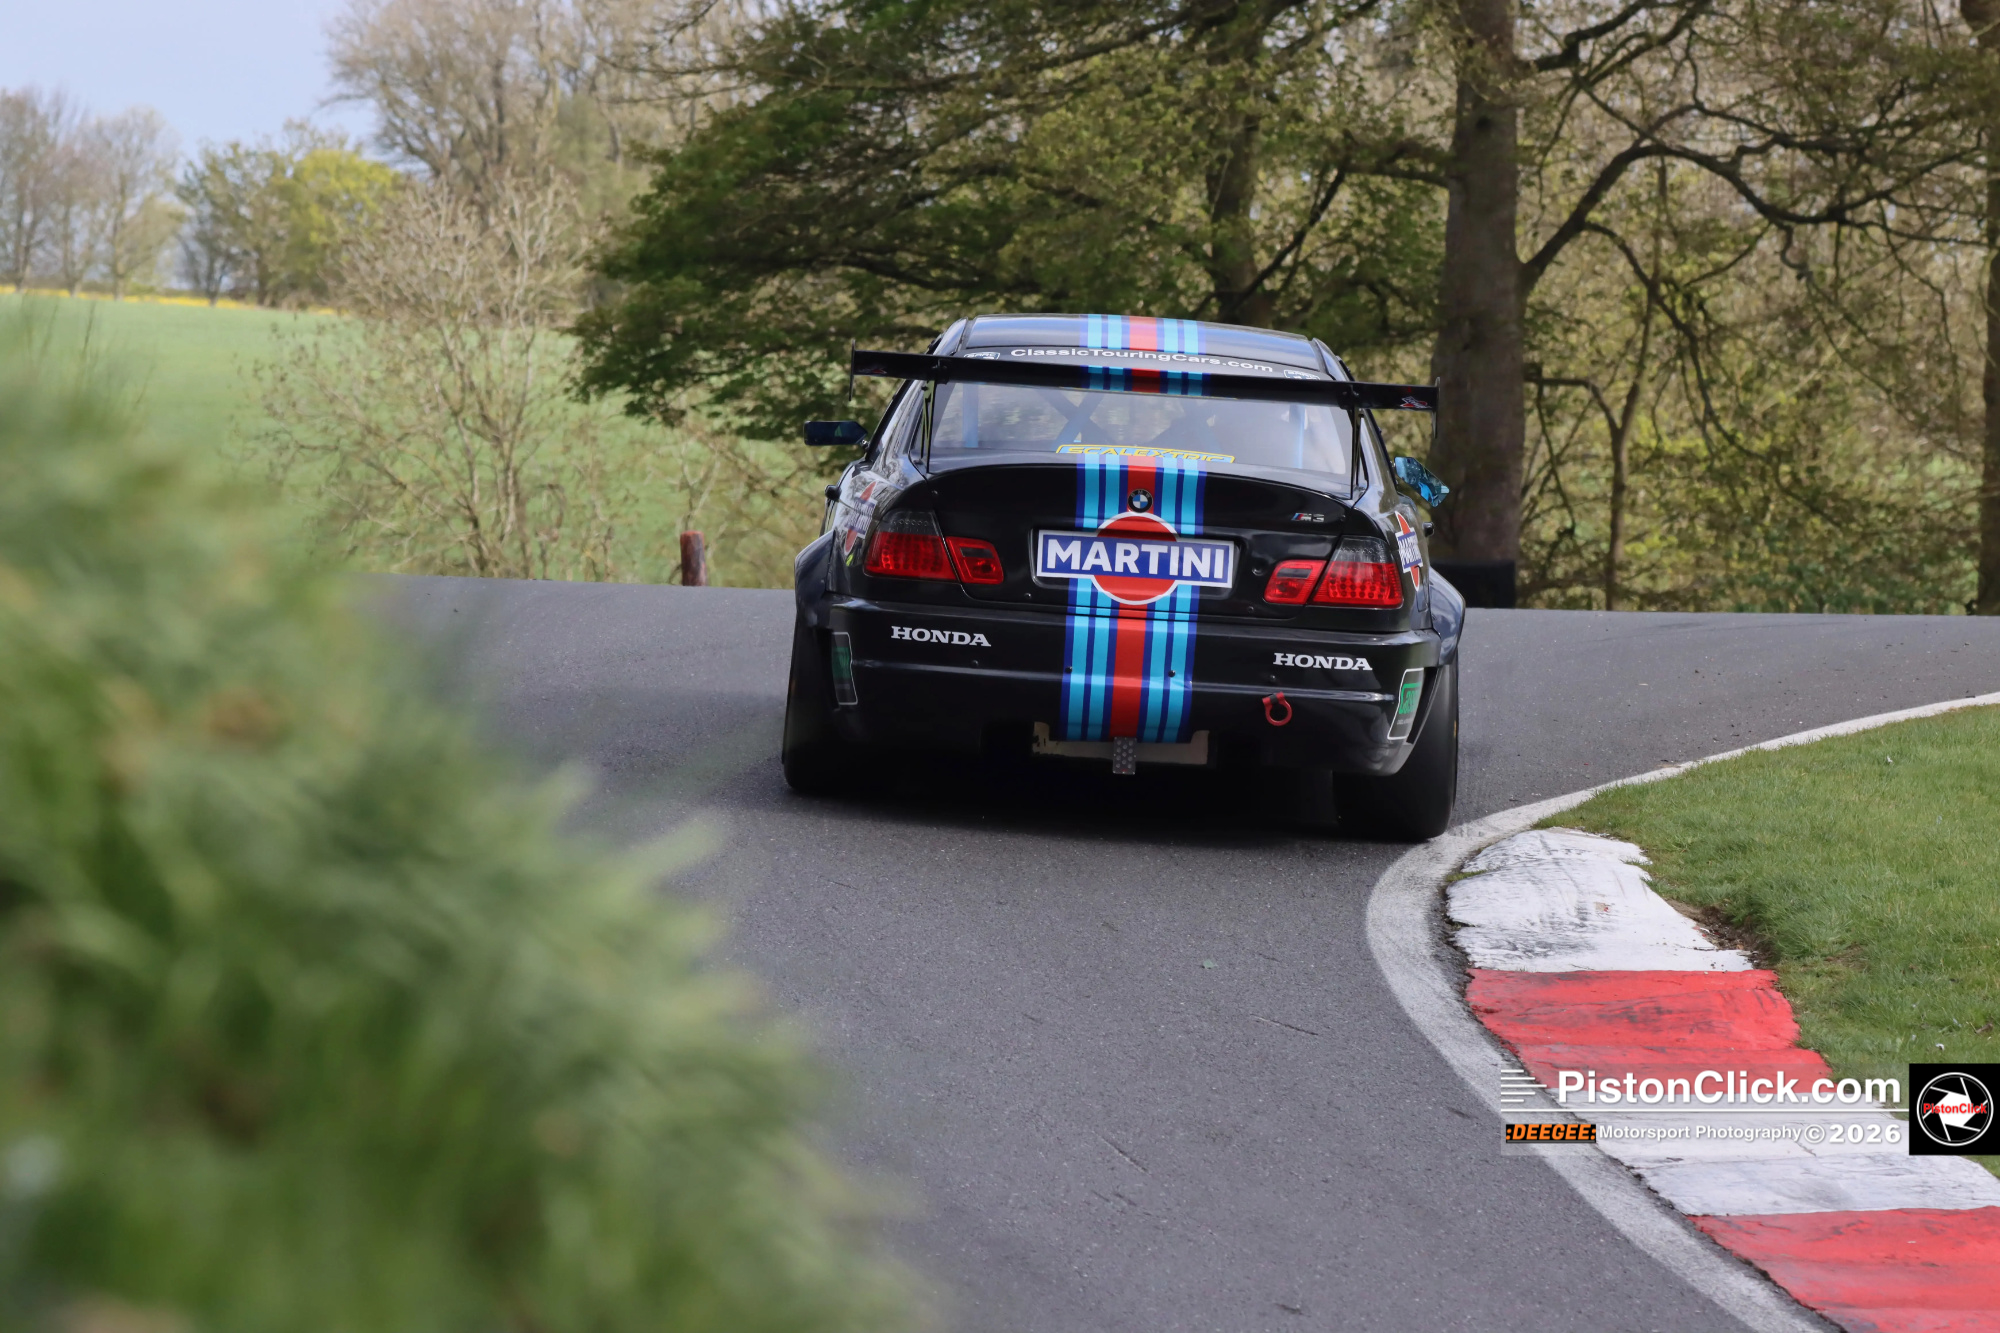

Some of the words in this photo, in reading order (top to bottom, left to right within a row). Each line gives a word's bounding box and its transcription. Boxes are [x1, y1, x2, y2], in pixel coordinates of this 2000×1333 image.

[1010, 348, 1273, 373] ClassicTouringCars.com
[1046, 538, 1225, 579] MARTINI
[890, 625, 992, 647] HONDA
[1272, 652, 1373, 671] HONDA
